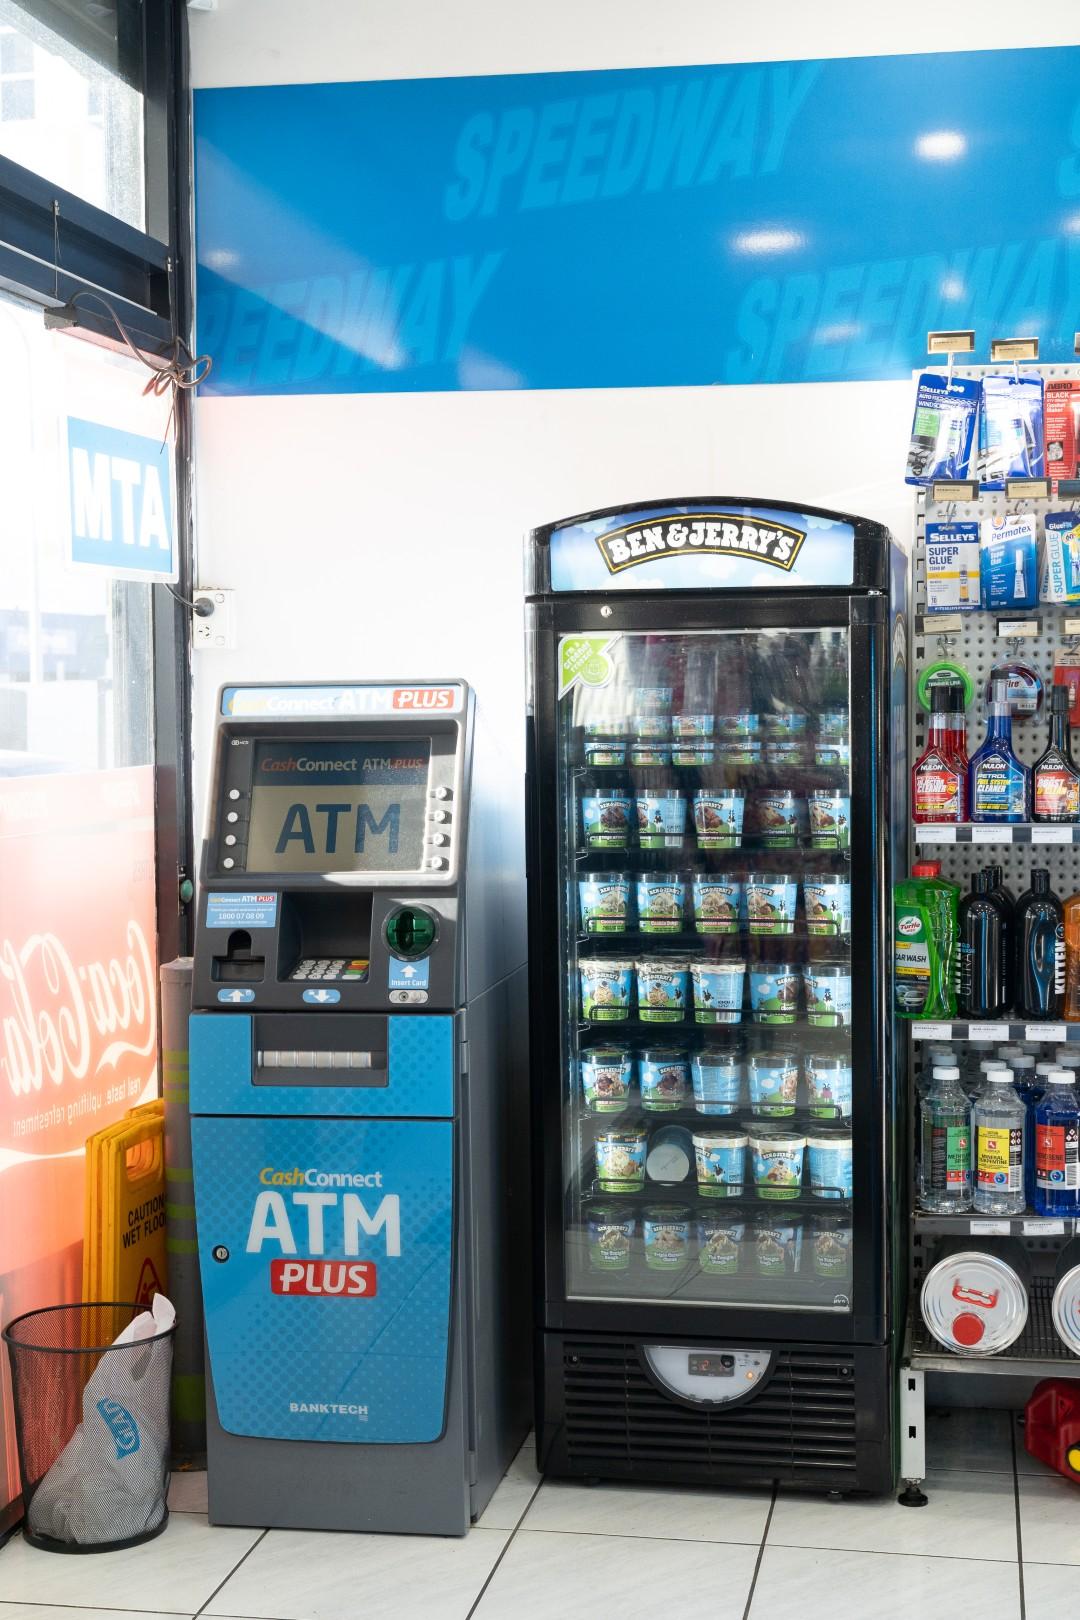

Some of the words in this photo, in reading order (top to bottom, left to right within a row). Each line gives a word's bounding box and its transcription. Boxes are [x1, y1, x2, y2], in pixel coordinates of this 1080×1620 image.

[441, 61, 827, 223] SPEEDWAY
[723, 234, 1080, 384] SPEEDWA
[929, 532, 976, 542] SELLEYS
[991, 525, 1032, 541] Permatex
[607, 524, 666, 564] BEN
[688, 522, 795, 562] JERRY'S
[928, 546, 959, 556] SUPER
[928, 555, 953, 565] GLUE
[397, 690, 451, 708] PLUS
[261, 757, 357, 772] CashConnect
[362, 759, 391, 770] ATM
[274, 803, 400, 854] ATM
[900, 922, 921, 930] Turtle
[906, 953, 927, 963] WASH
[1055, 941, 1066, 995] KITTEN
[391, 979, 410, 987] Insert
[411, 979, 426, 987] Card
[259, 1167, 383, 1188] CashConnect
[246, 1190, 402, 1257] ATM
[122, 1225, 141, 1249] WET
[279, 1263, 368, 1294] PLUS
[289, 1402, 368, 1415] BANKTECH
